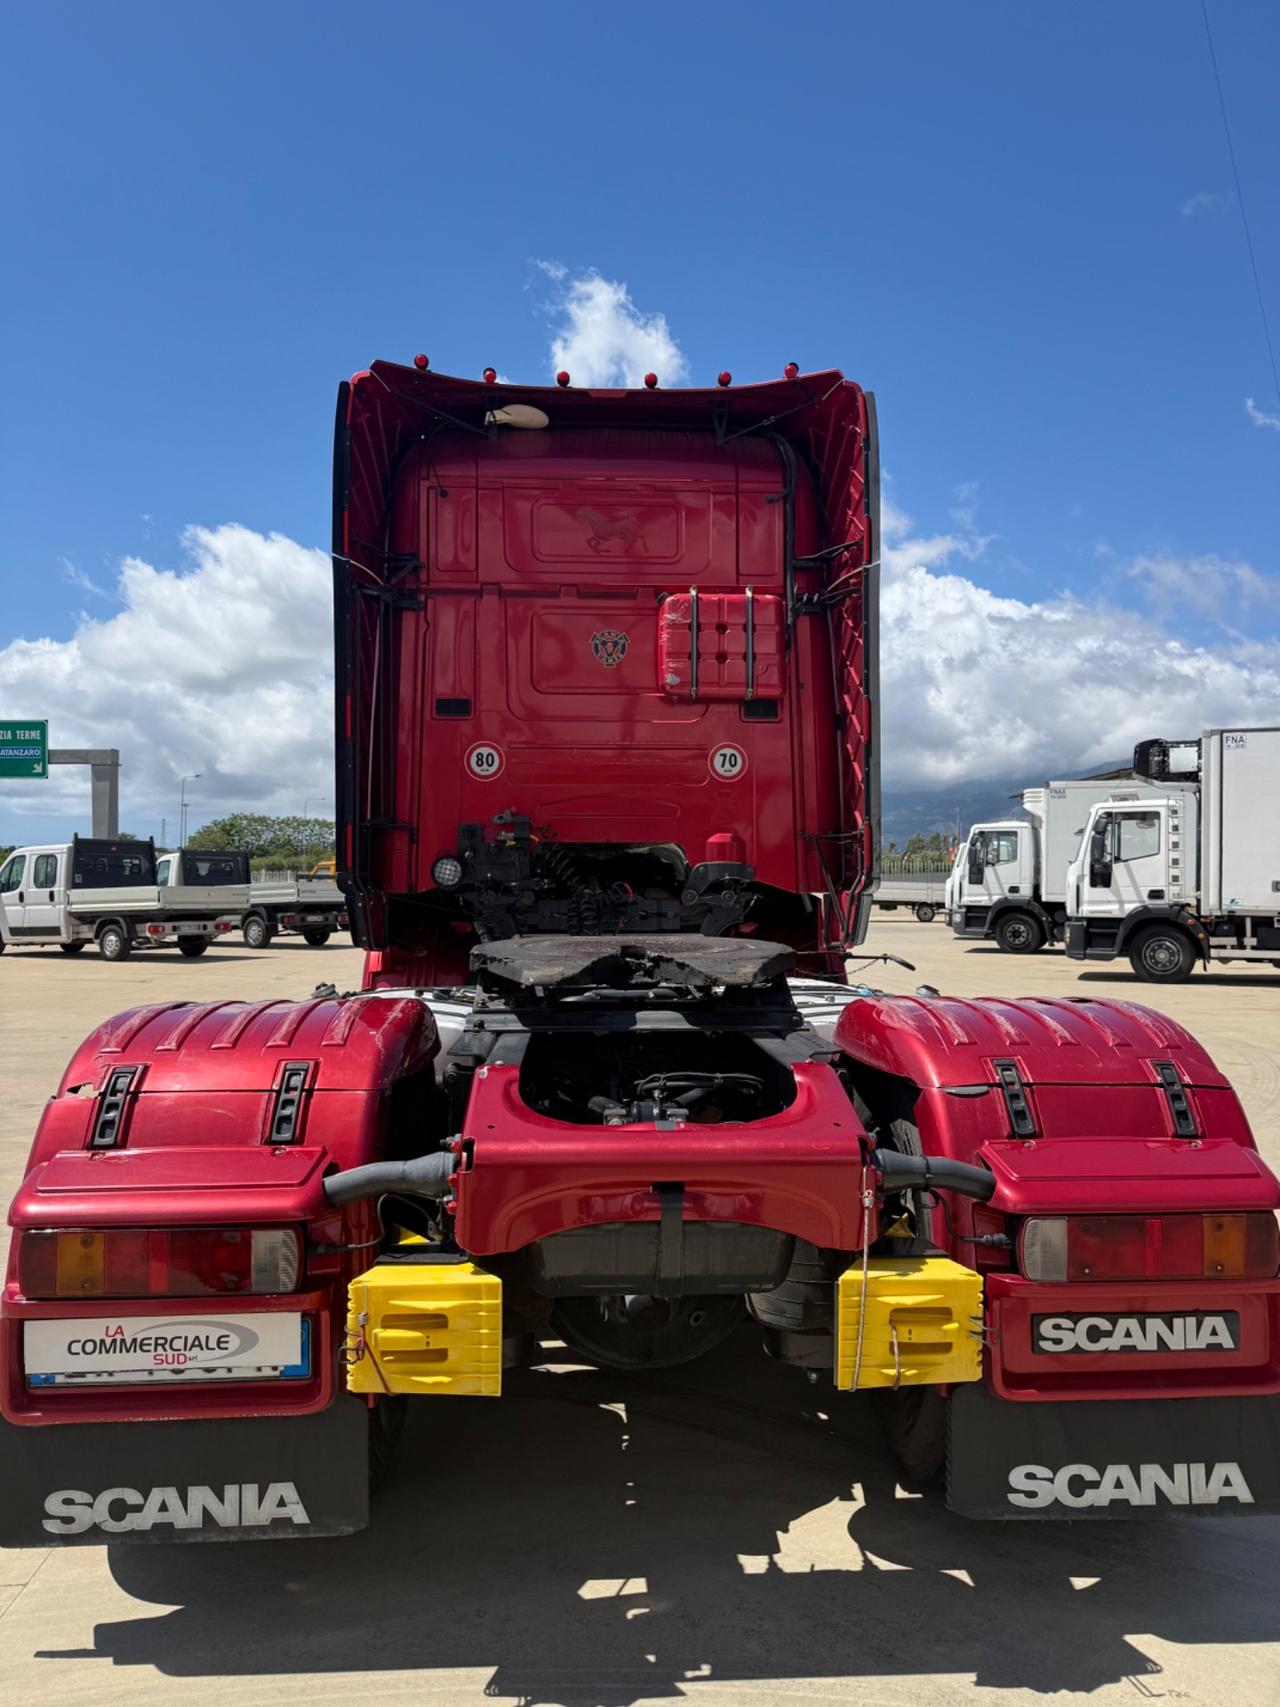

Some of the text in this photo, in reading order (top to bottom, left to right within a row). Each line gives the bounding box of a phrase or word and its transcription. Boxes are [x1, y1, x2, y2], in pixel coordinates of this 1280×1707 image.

[16, 730, 41, 740] TERME
[475, 752, 495, 768] 80
[719, 752, 738, 768] 70
[104, 1325, 125, 1338] LA
[1038, 1316, 1235, 1352] SCANIA
[67, 1334, 231, 1356] COMMERCIALE
[153, 1352, 188, 1366] SUD
[1006, 1462, 1255, 1508] SCANIA
[42, 1481, 311, 1535] SCANIA
